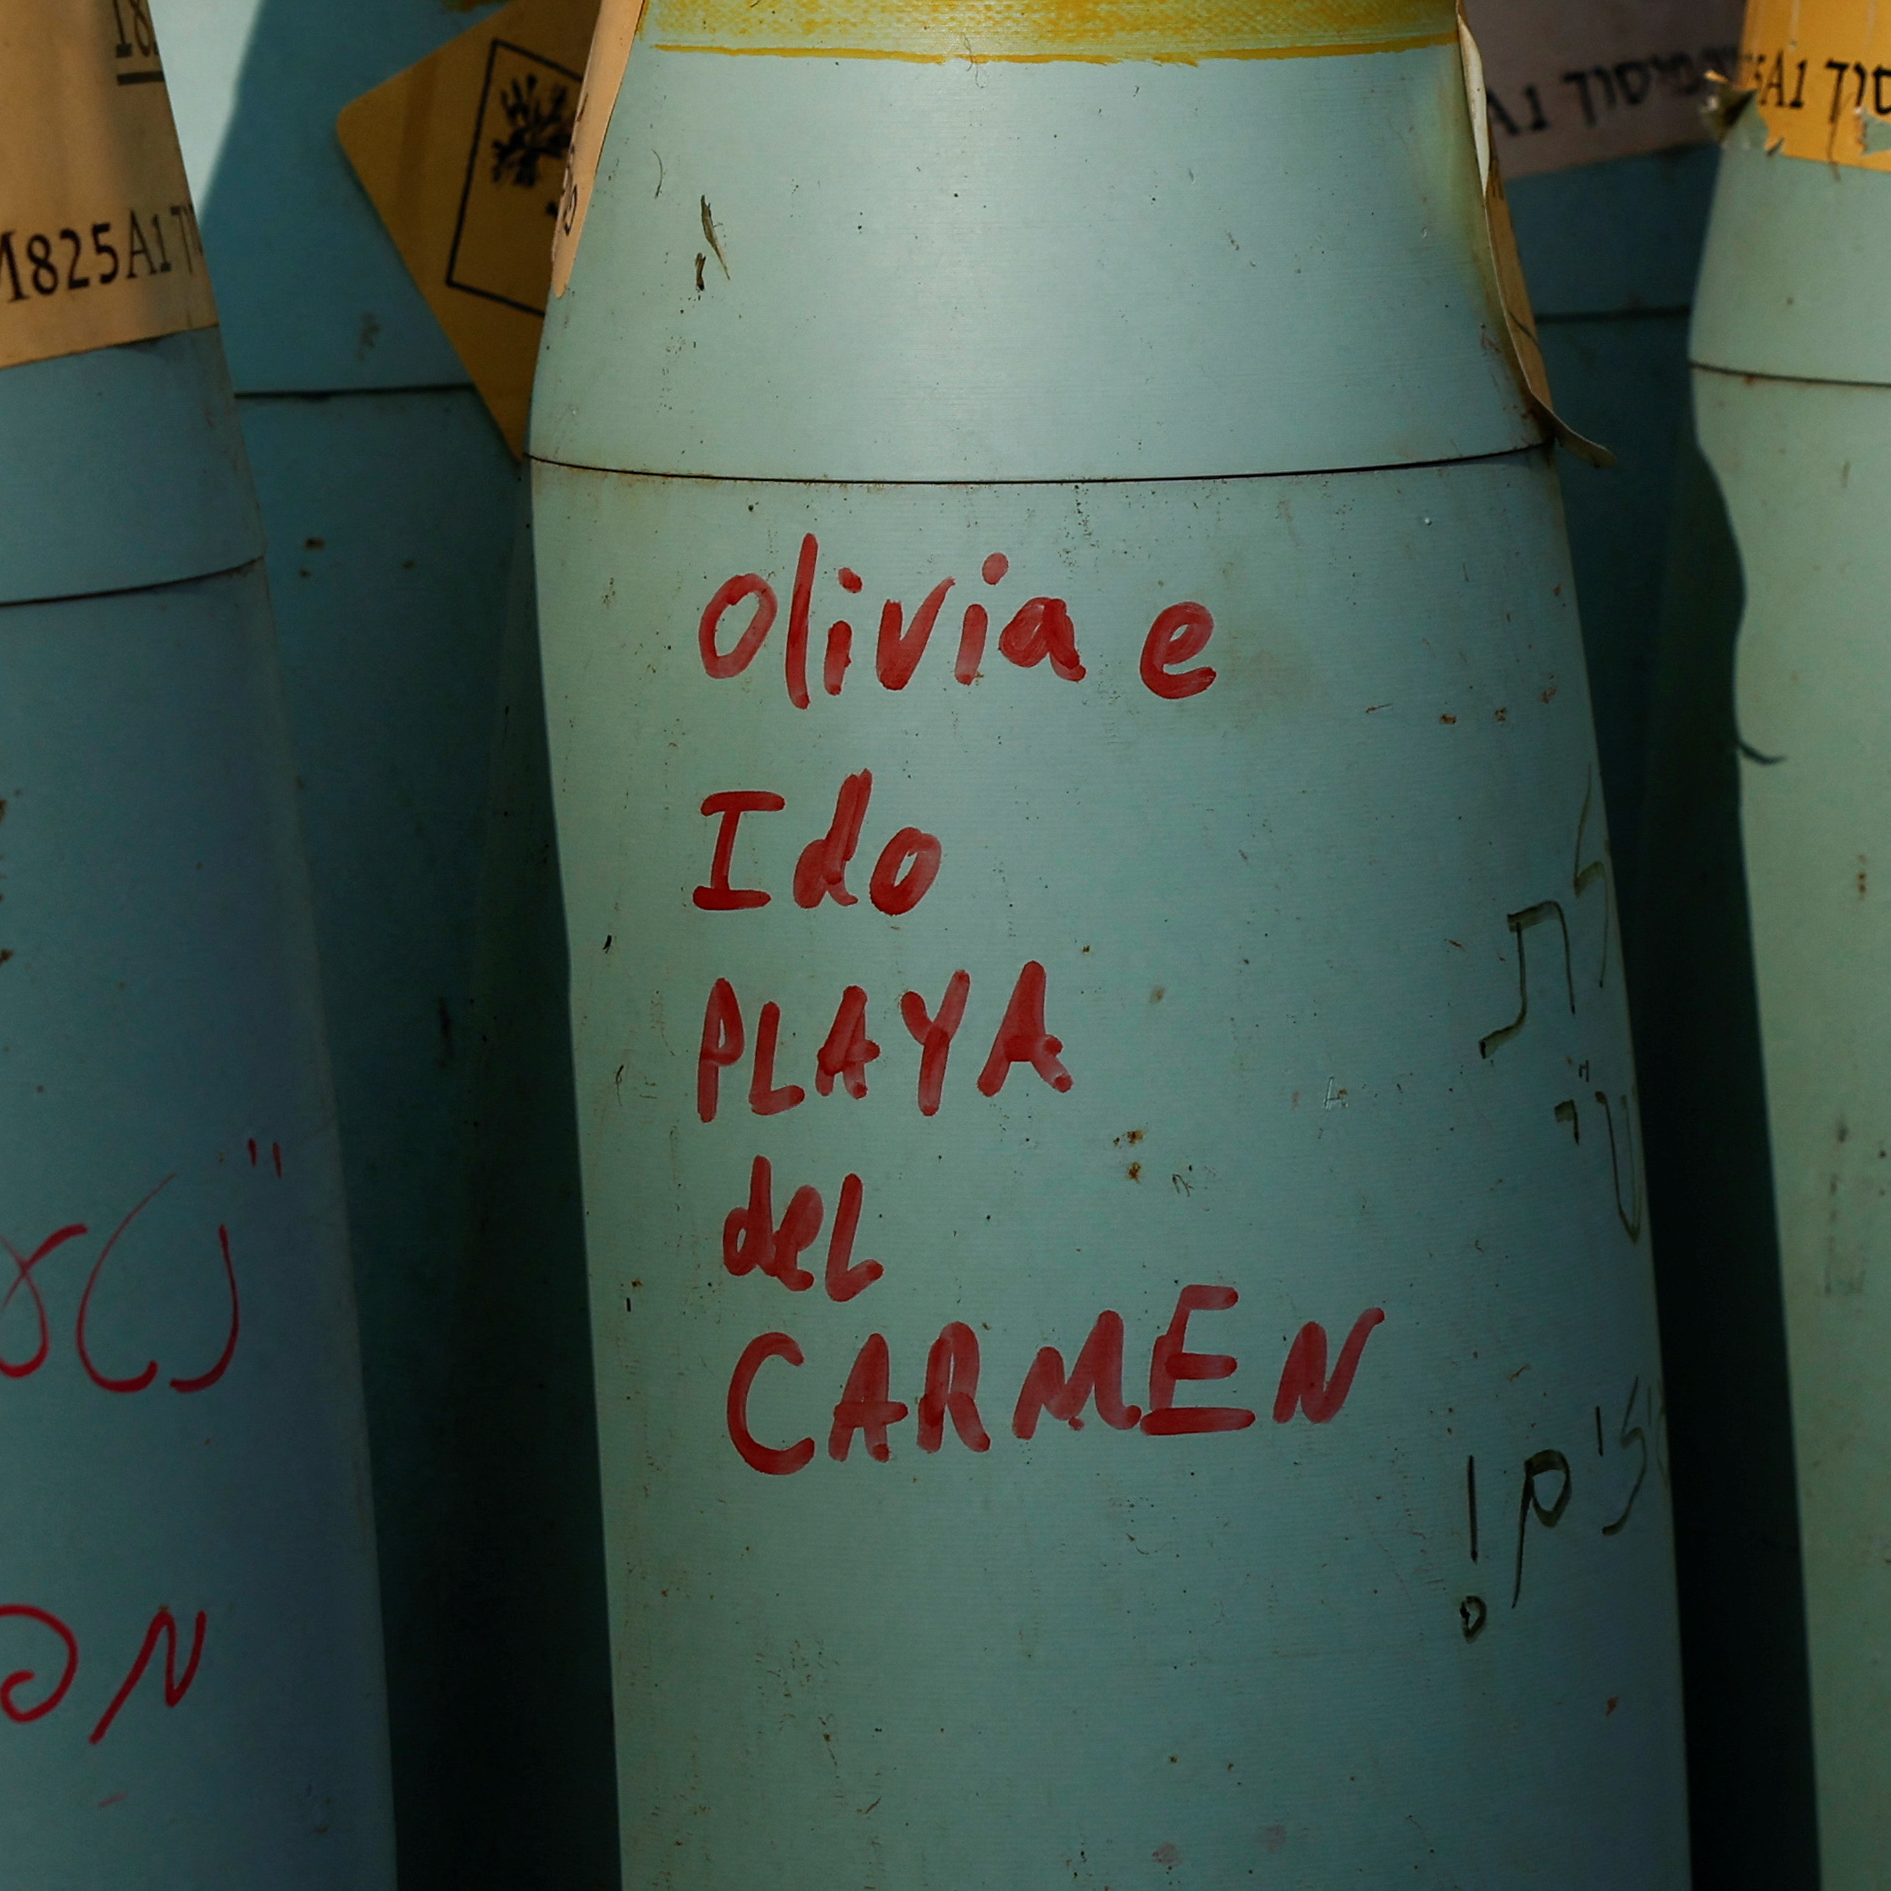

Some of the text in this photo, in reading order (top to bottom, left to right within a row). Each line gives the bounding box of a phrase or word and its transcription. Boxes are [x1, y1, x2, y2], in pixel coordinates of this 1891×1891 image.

[697, 533, 1217, 709] Olivia e
[692, 768, 942, 916] Ido
[696, 960, 1074, 1123] PLAYA
[726, 1284, 1386, 1475] CARMEN
